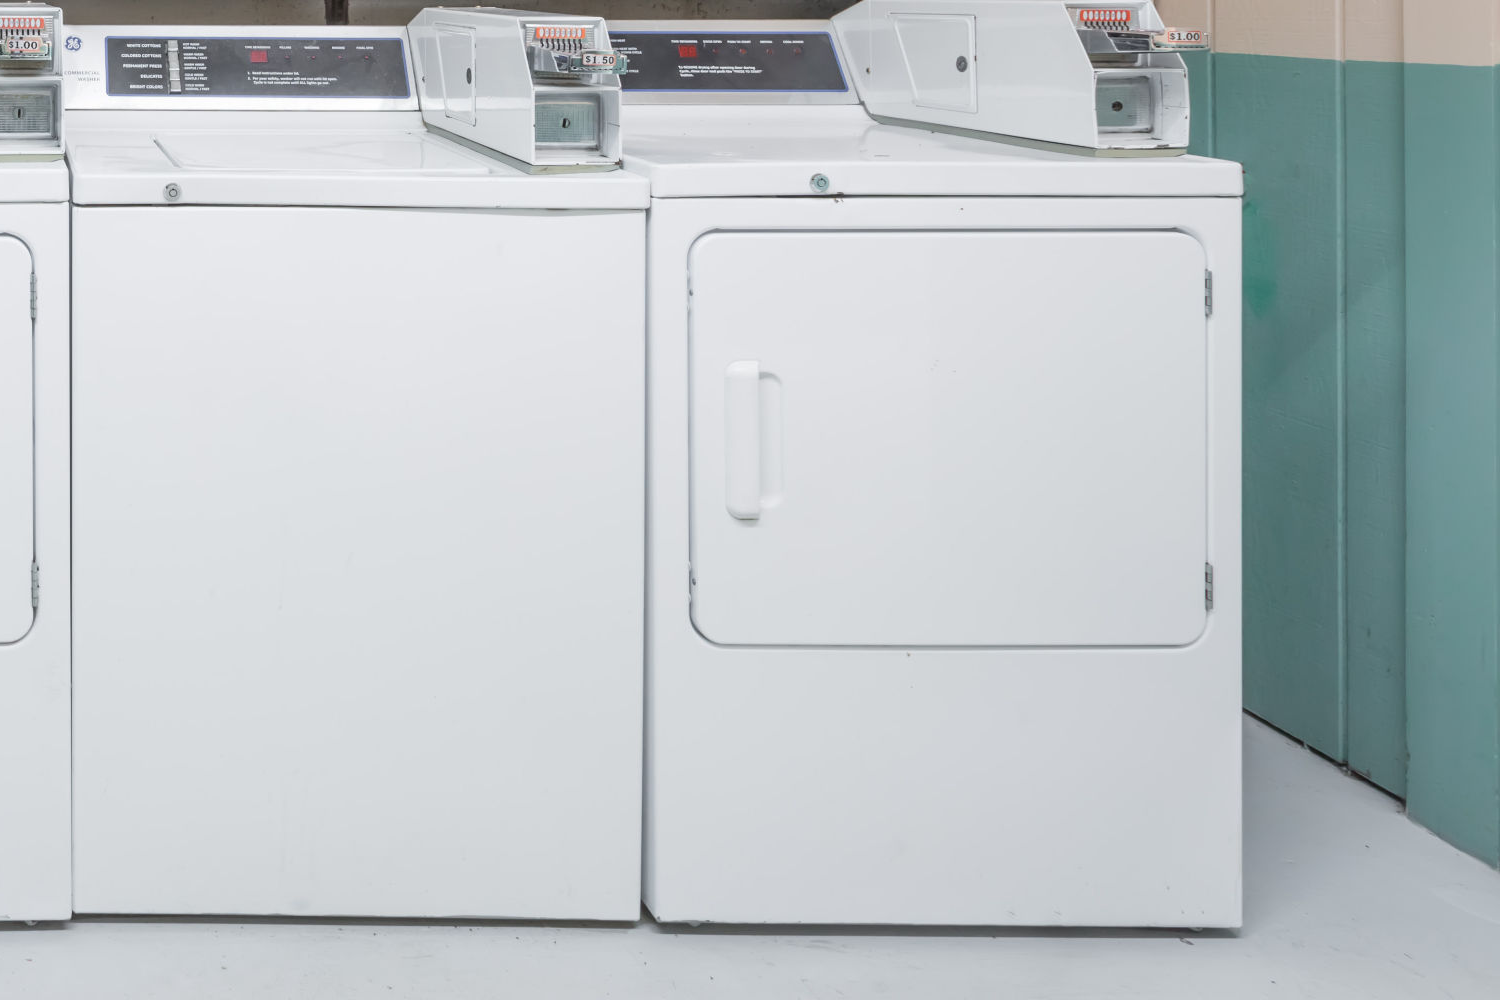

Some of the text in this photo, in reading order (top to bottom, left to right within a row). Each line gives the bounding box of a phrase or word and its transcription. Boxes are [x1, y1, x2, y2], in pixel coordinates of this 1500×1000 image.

[1169, 32, 1200, 41] $1.00
[8, 41, 38, 50] $1.00
[585, 55, 615, 65] $1.50
